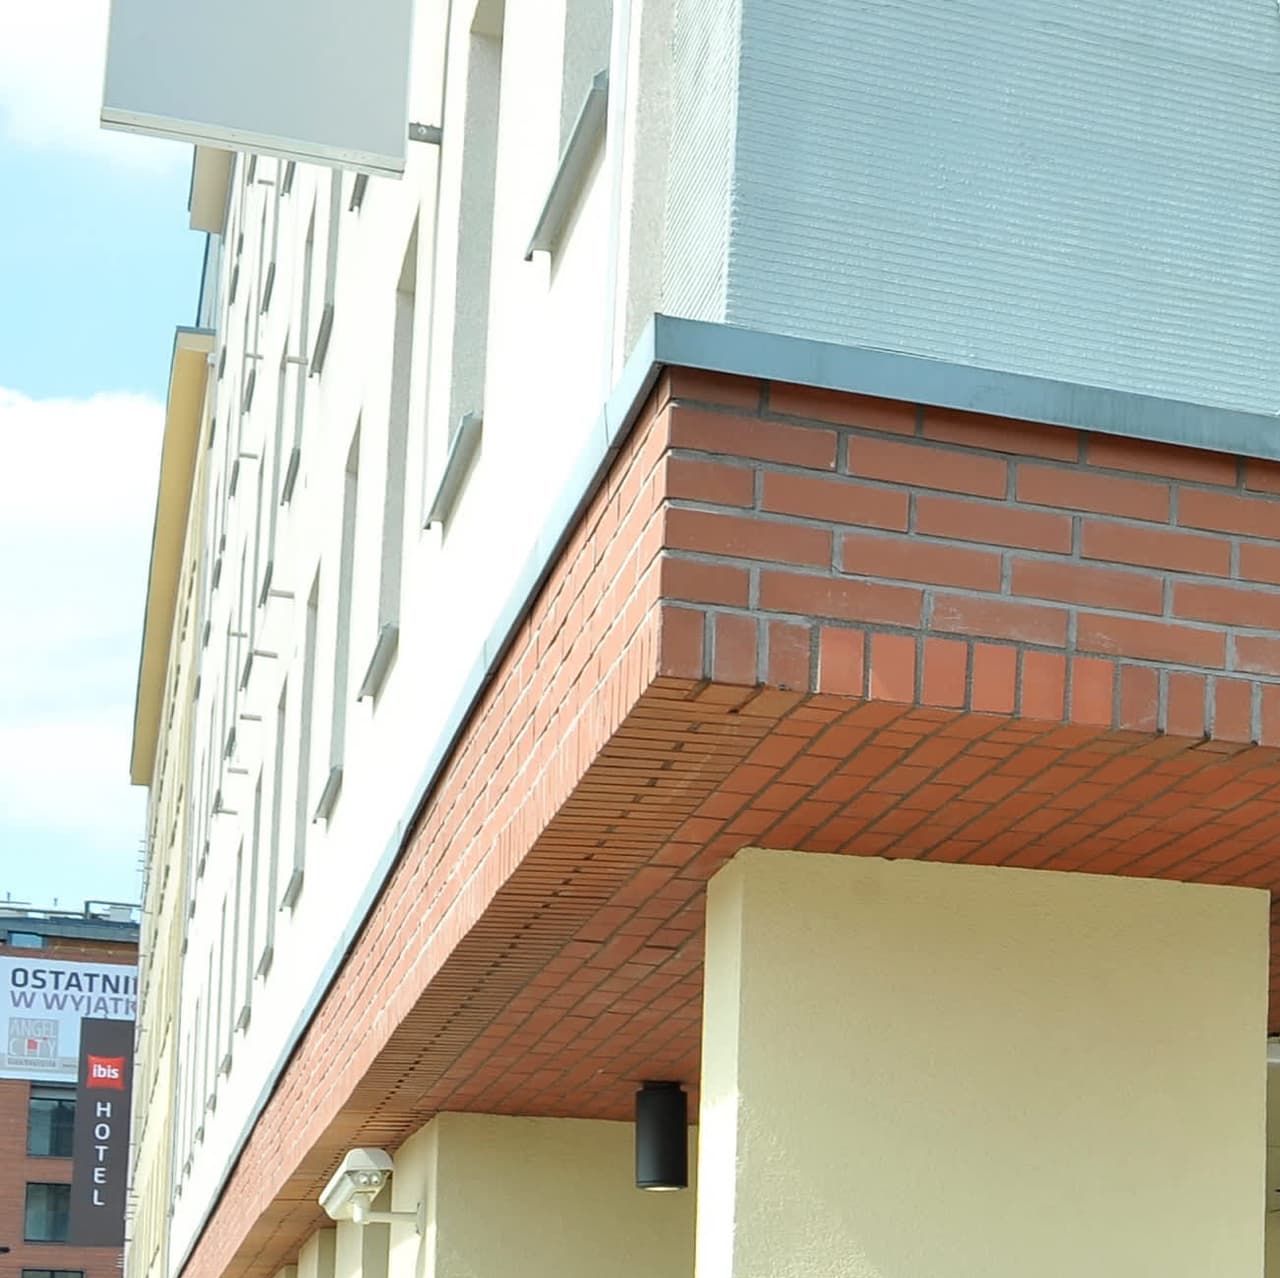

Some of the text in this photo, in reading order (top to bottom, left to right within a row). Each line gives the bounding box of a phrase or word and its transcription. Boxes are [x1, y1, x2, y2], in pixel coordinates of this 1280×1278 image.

[11, 967, 137, 995] OSTATNI
[10, 990, 36, 1008] W
[92, 1063, 119, 1079] ibis
[92, 1101, 111, 1206] HOTEL
